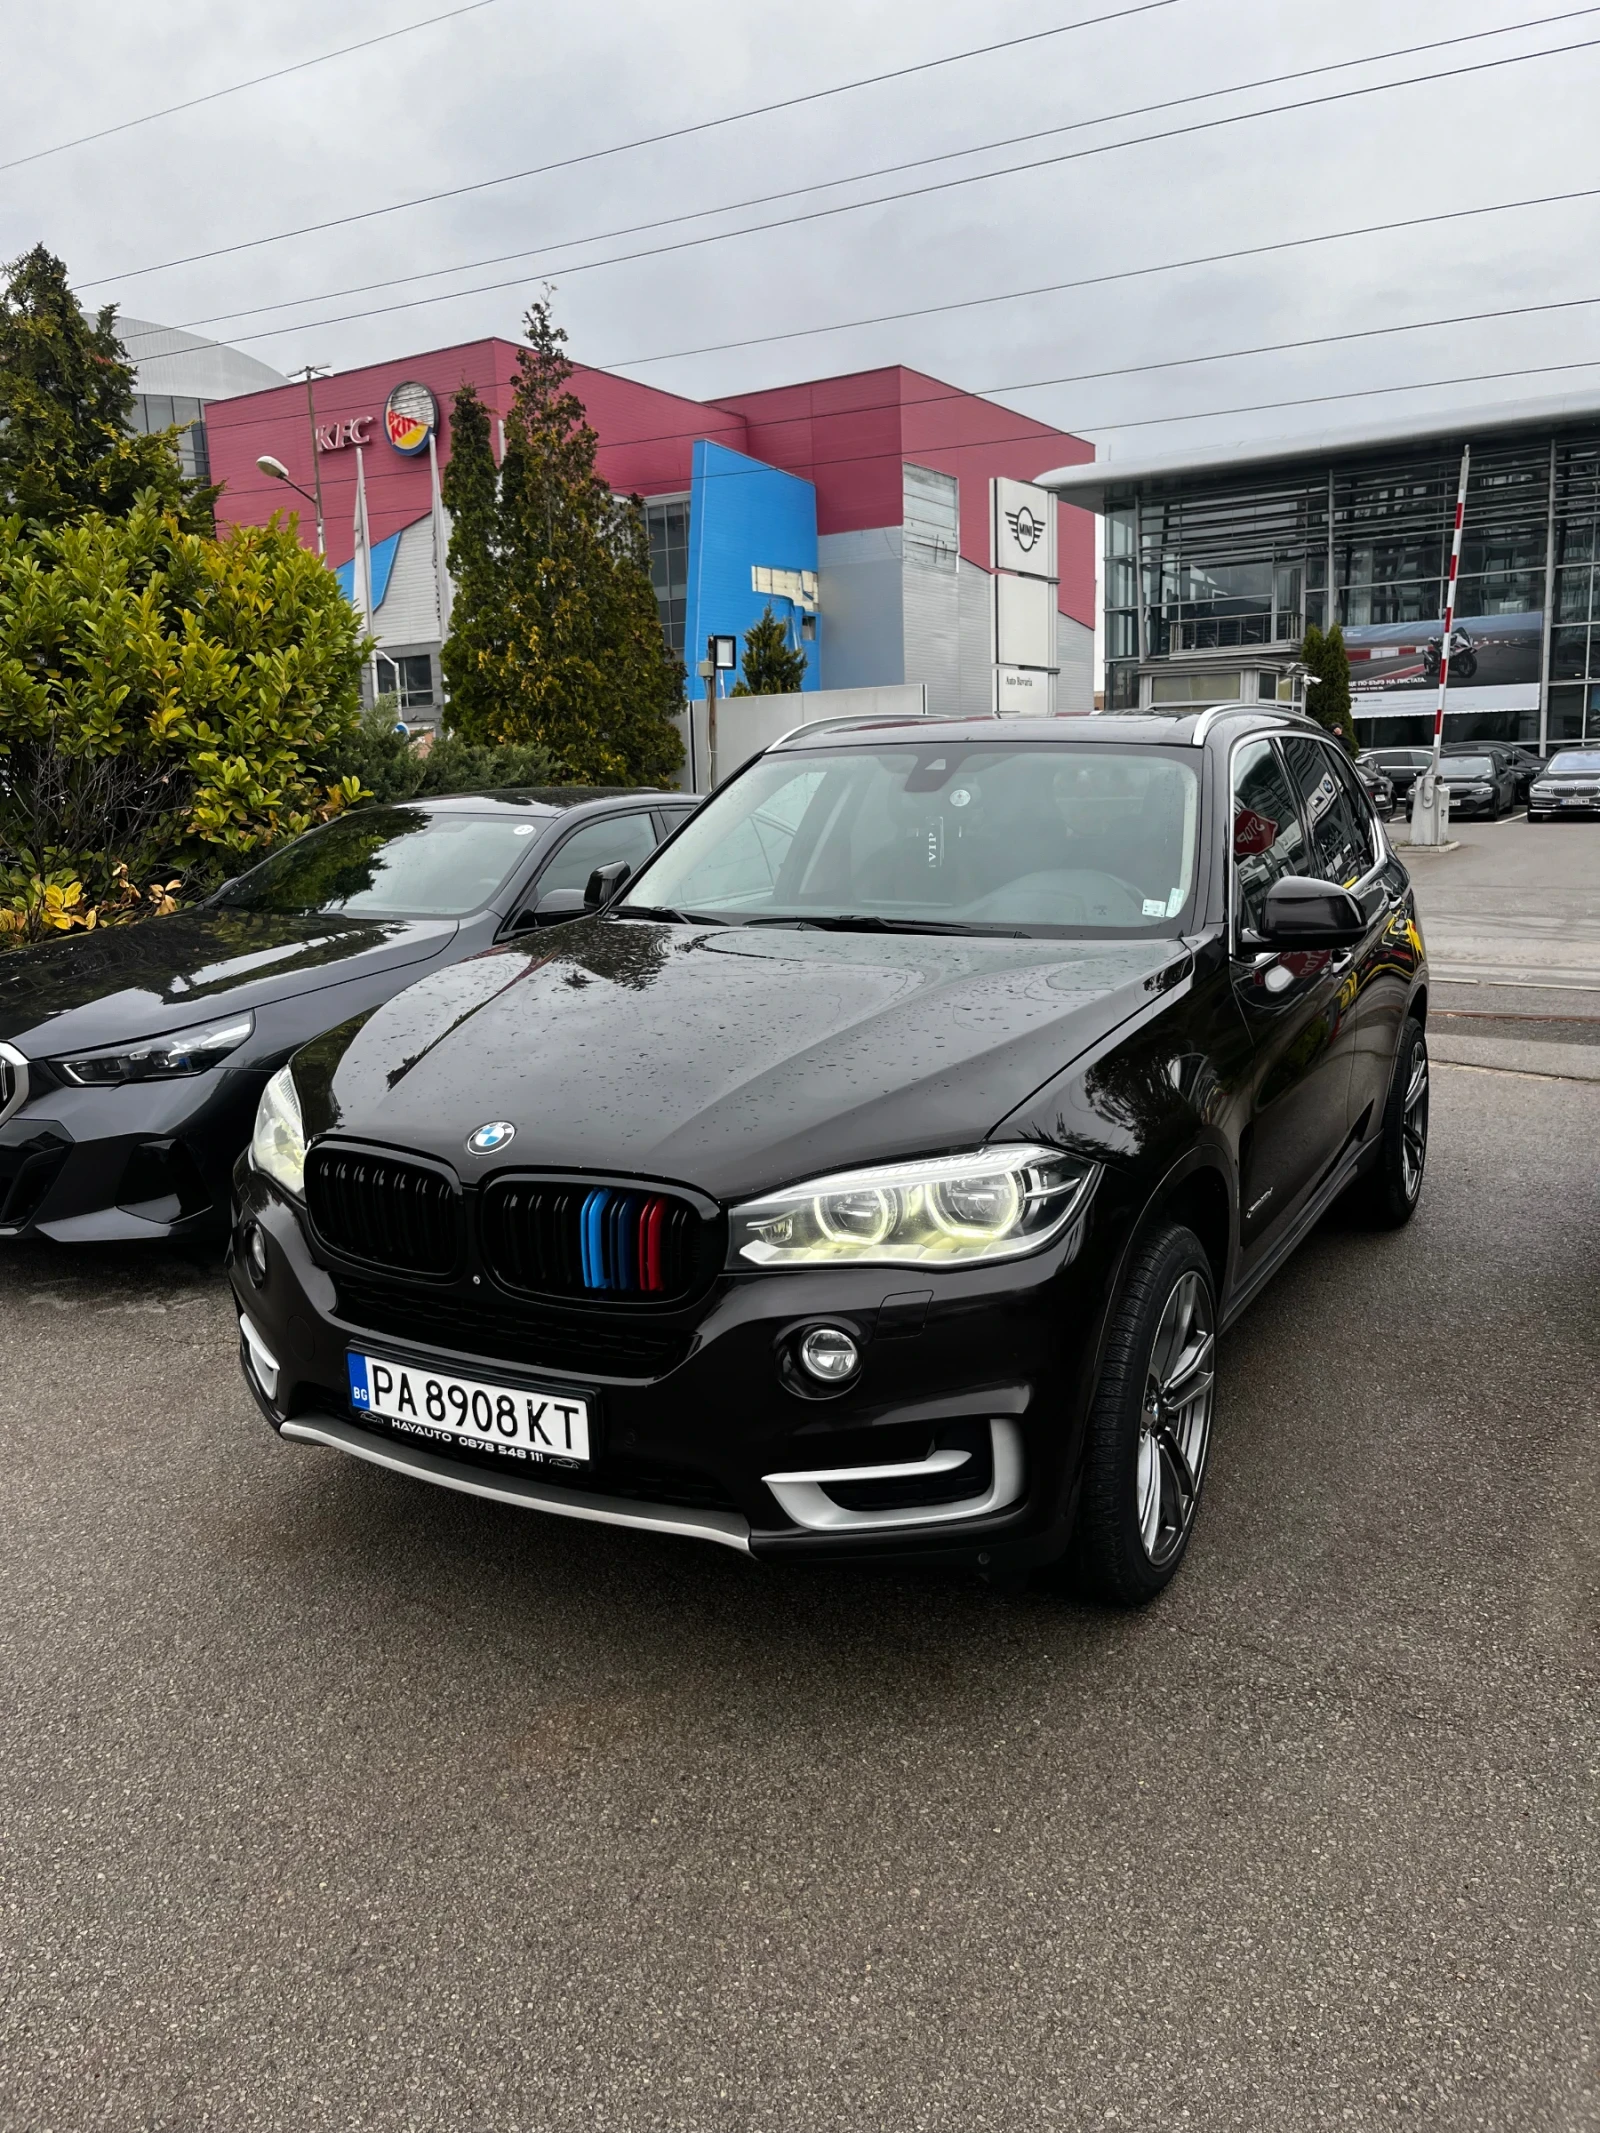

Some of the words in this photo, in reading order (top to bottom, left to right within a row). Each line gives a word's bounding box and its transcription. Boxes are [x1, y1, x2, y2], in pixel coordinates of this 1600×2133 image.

[315, 416, 373, 452] KFC
[1019, 522, 1033, 537] MINI
[353, 1386, 368, 1401] BG
[372, 1364, 418, 1416] PA
[425, 1379, 518, 1438] 8908
[526, 1398, 580, 1450] KT
[391, 1418, 452, 1443] HAYAUTO
[458, 1436, 495, 1452] 0878
[498, 1444, 527, 1459] 548
[529, 1451, 544, 1463] 111
